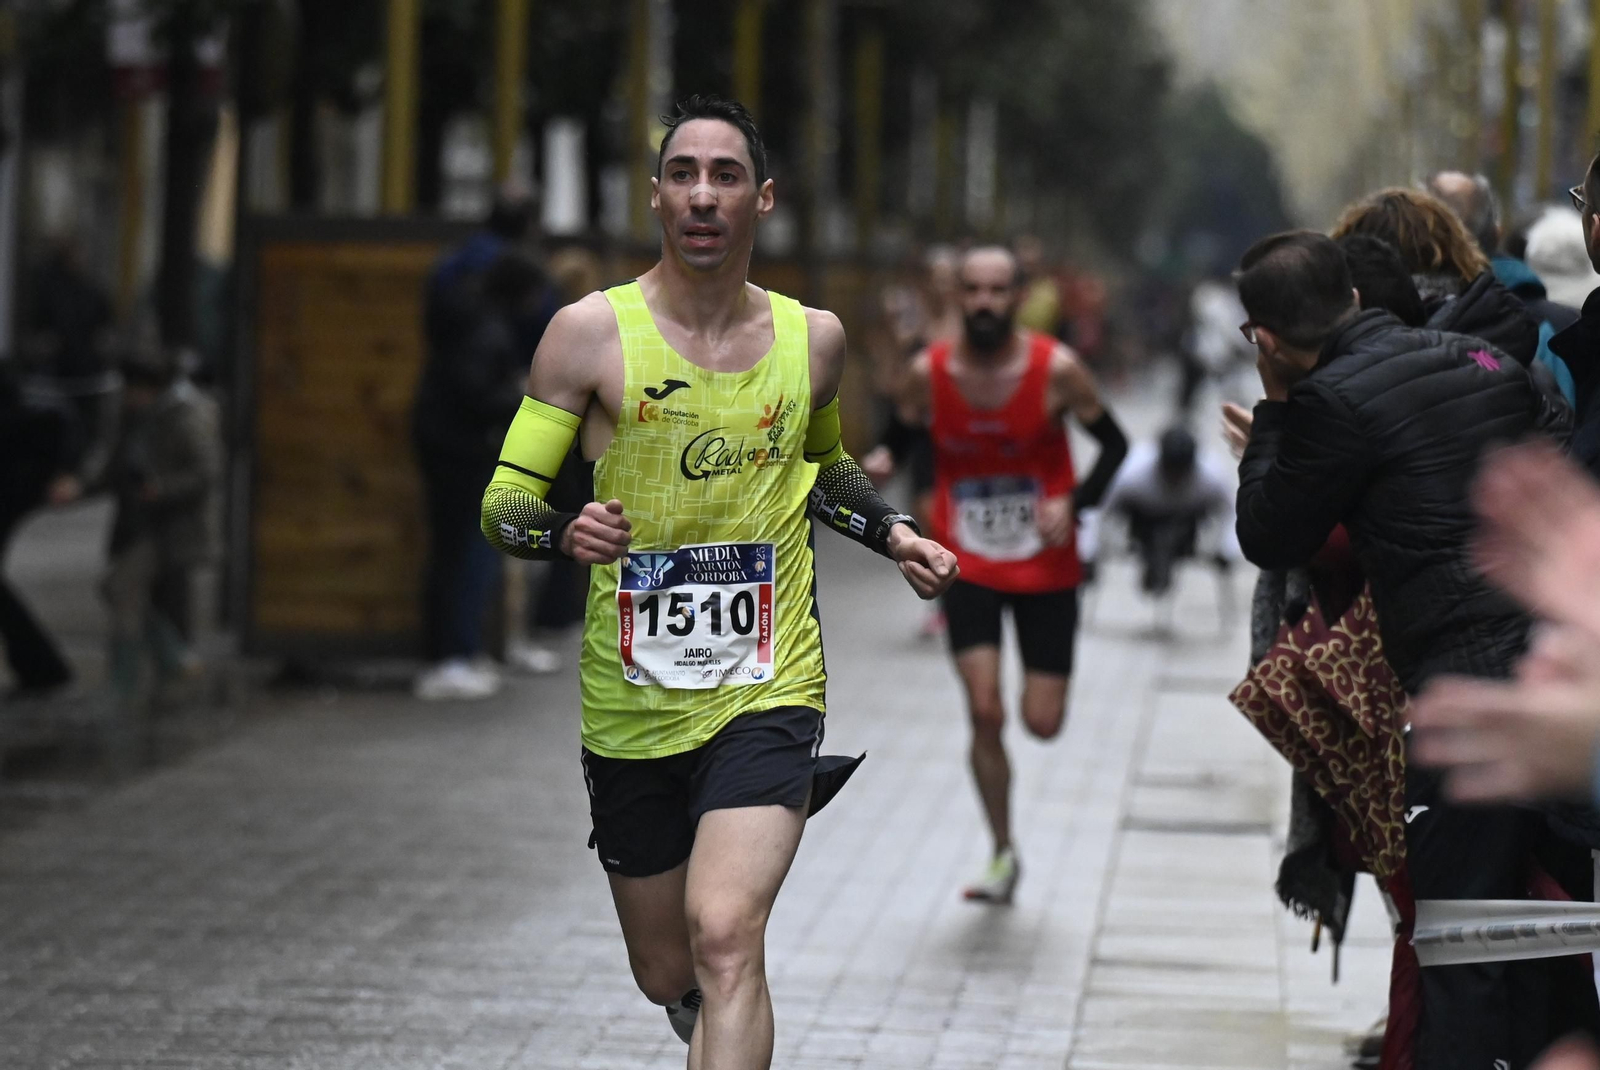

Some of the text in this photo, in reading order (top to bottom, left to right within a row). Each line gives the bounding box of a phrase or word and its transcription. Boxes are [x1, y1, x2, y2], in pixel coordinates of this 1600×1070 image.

[662, 407, 700, 420] Diputación
[661, 416, 699, 427] de Córdoba
[711, 467, 743, 476] METAL
[690, 546, 741, 562] MEDIA
[690, 560, 742, 572] MARATÓN
[637, 566, 664, 588] 39
[684, 571, 748, 582] CÓRDOBA
[638, 590, 756, 637] 1510
[623, 615, 631, 647] CAJÓN
[761, 612, 769, 644] CAJÓN
[683, 647, 713, 659] JAIRO
